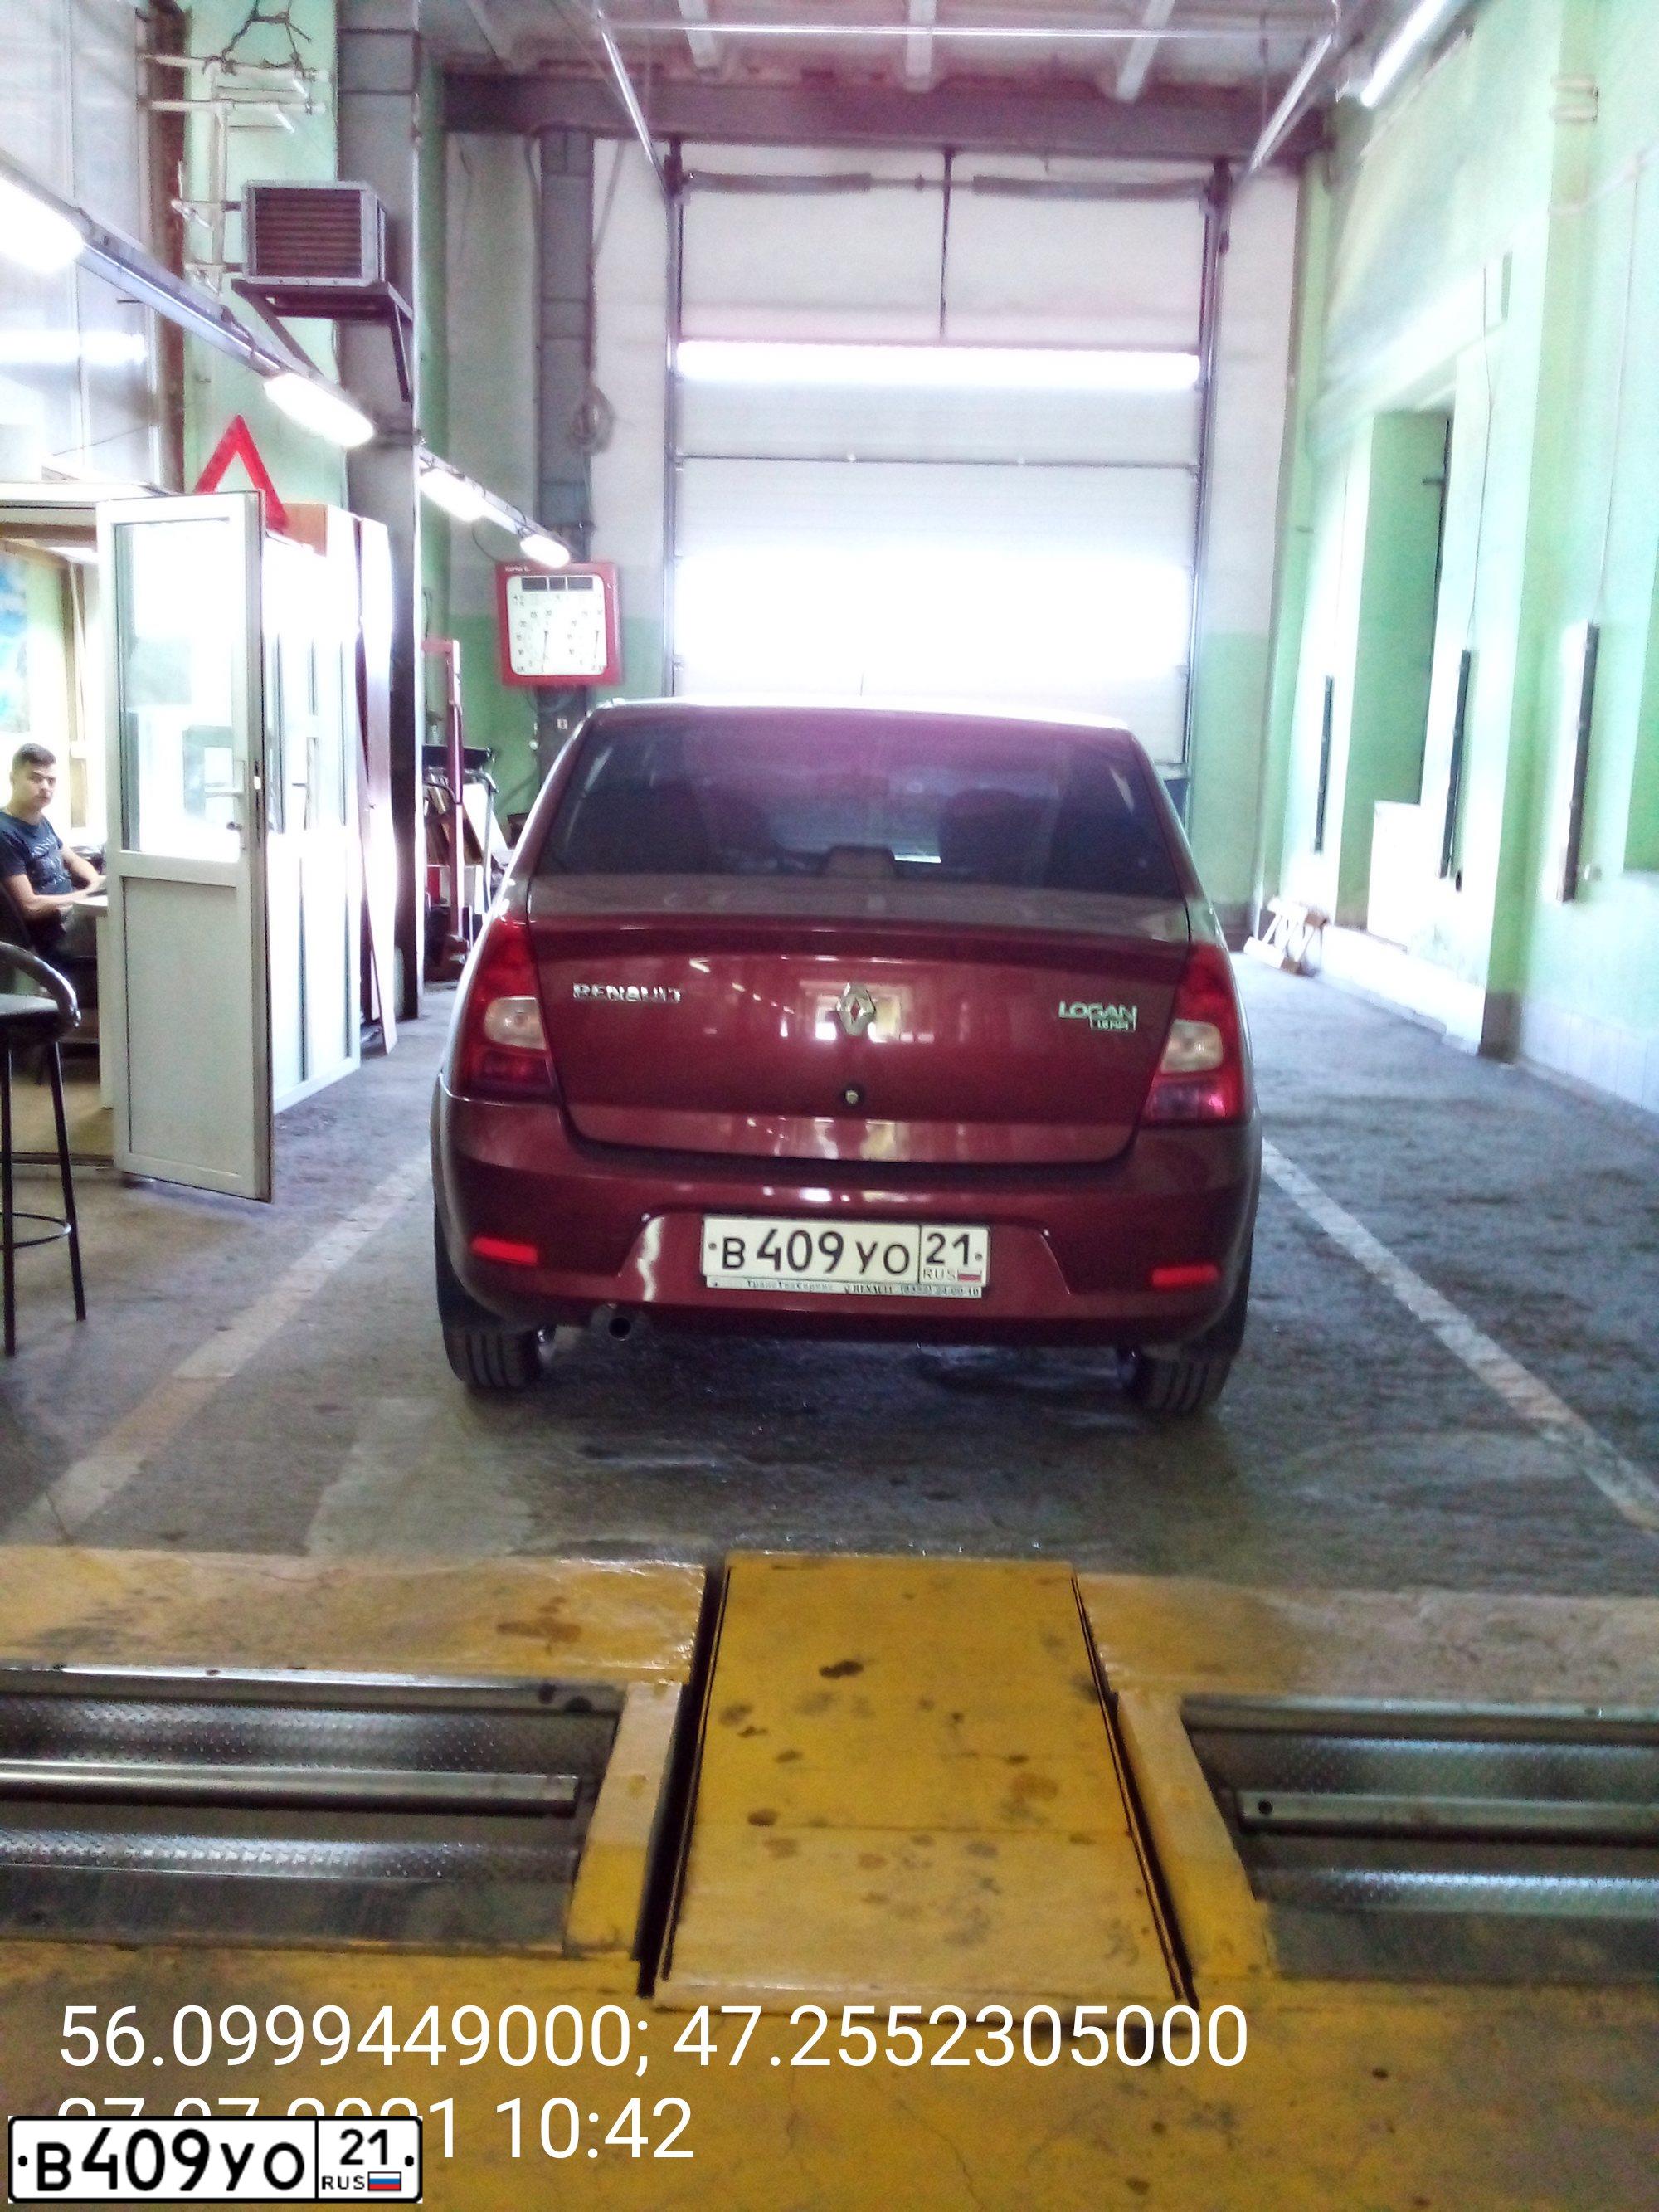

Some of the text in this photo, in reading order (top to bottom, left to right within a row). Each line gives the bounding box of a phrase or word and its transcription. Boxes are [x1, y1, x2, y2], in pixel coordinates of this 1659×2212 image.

[1058, 1001, 1137, 1021] LOGAN
[926, 1232, 970, 1265] 21
[922, 1268, 956, 1280] RUS
